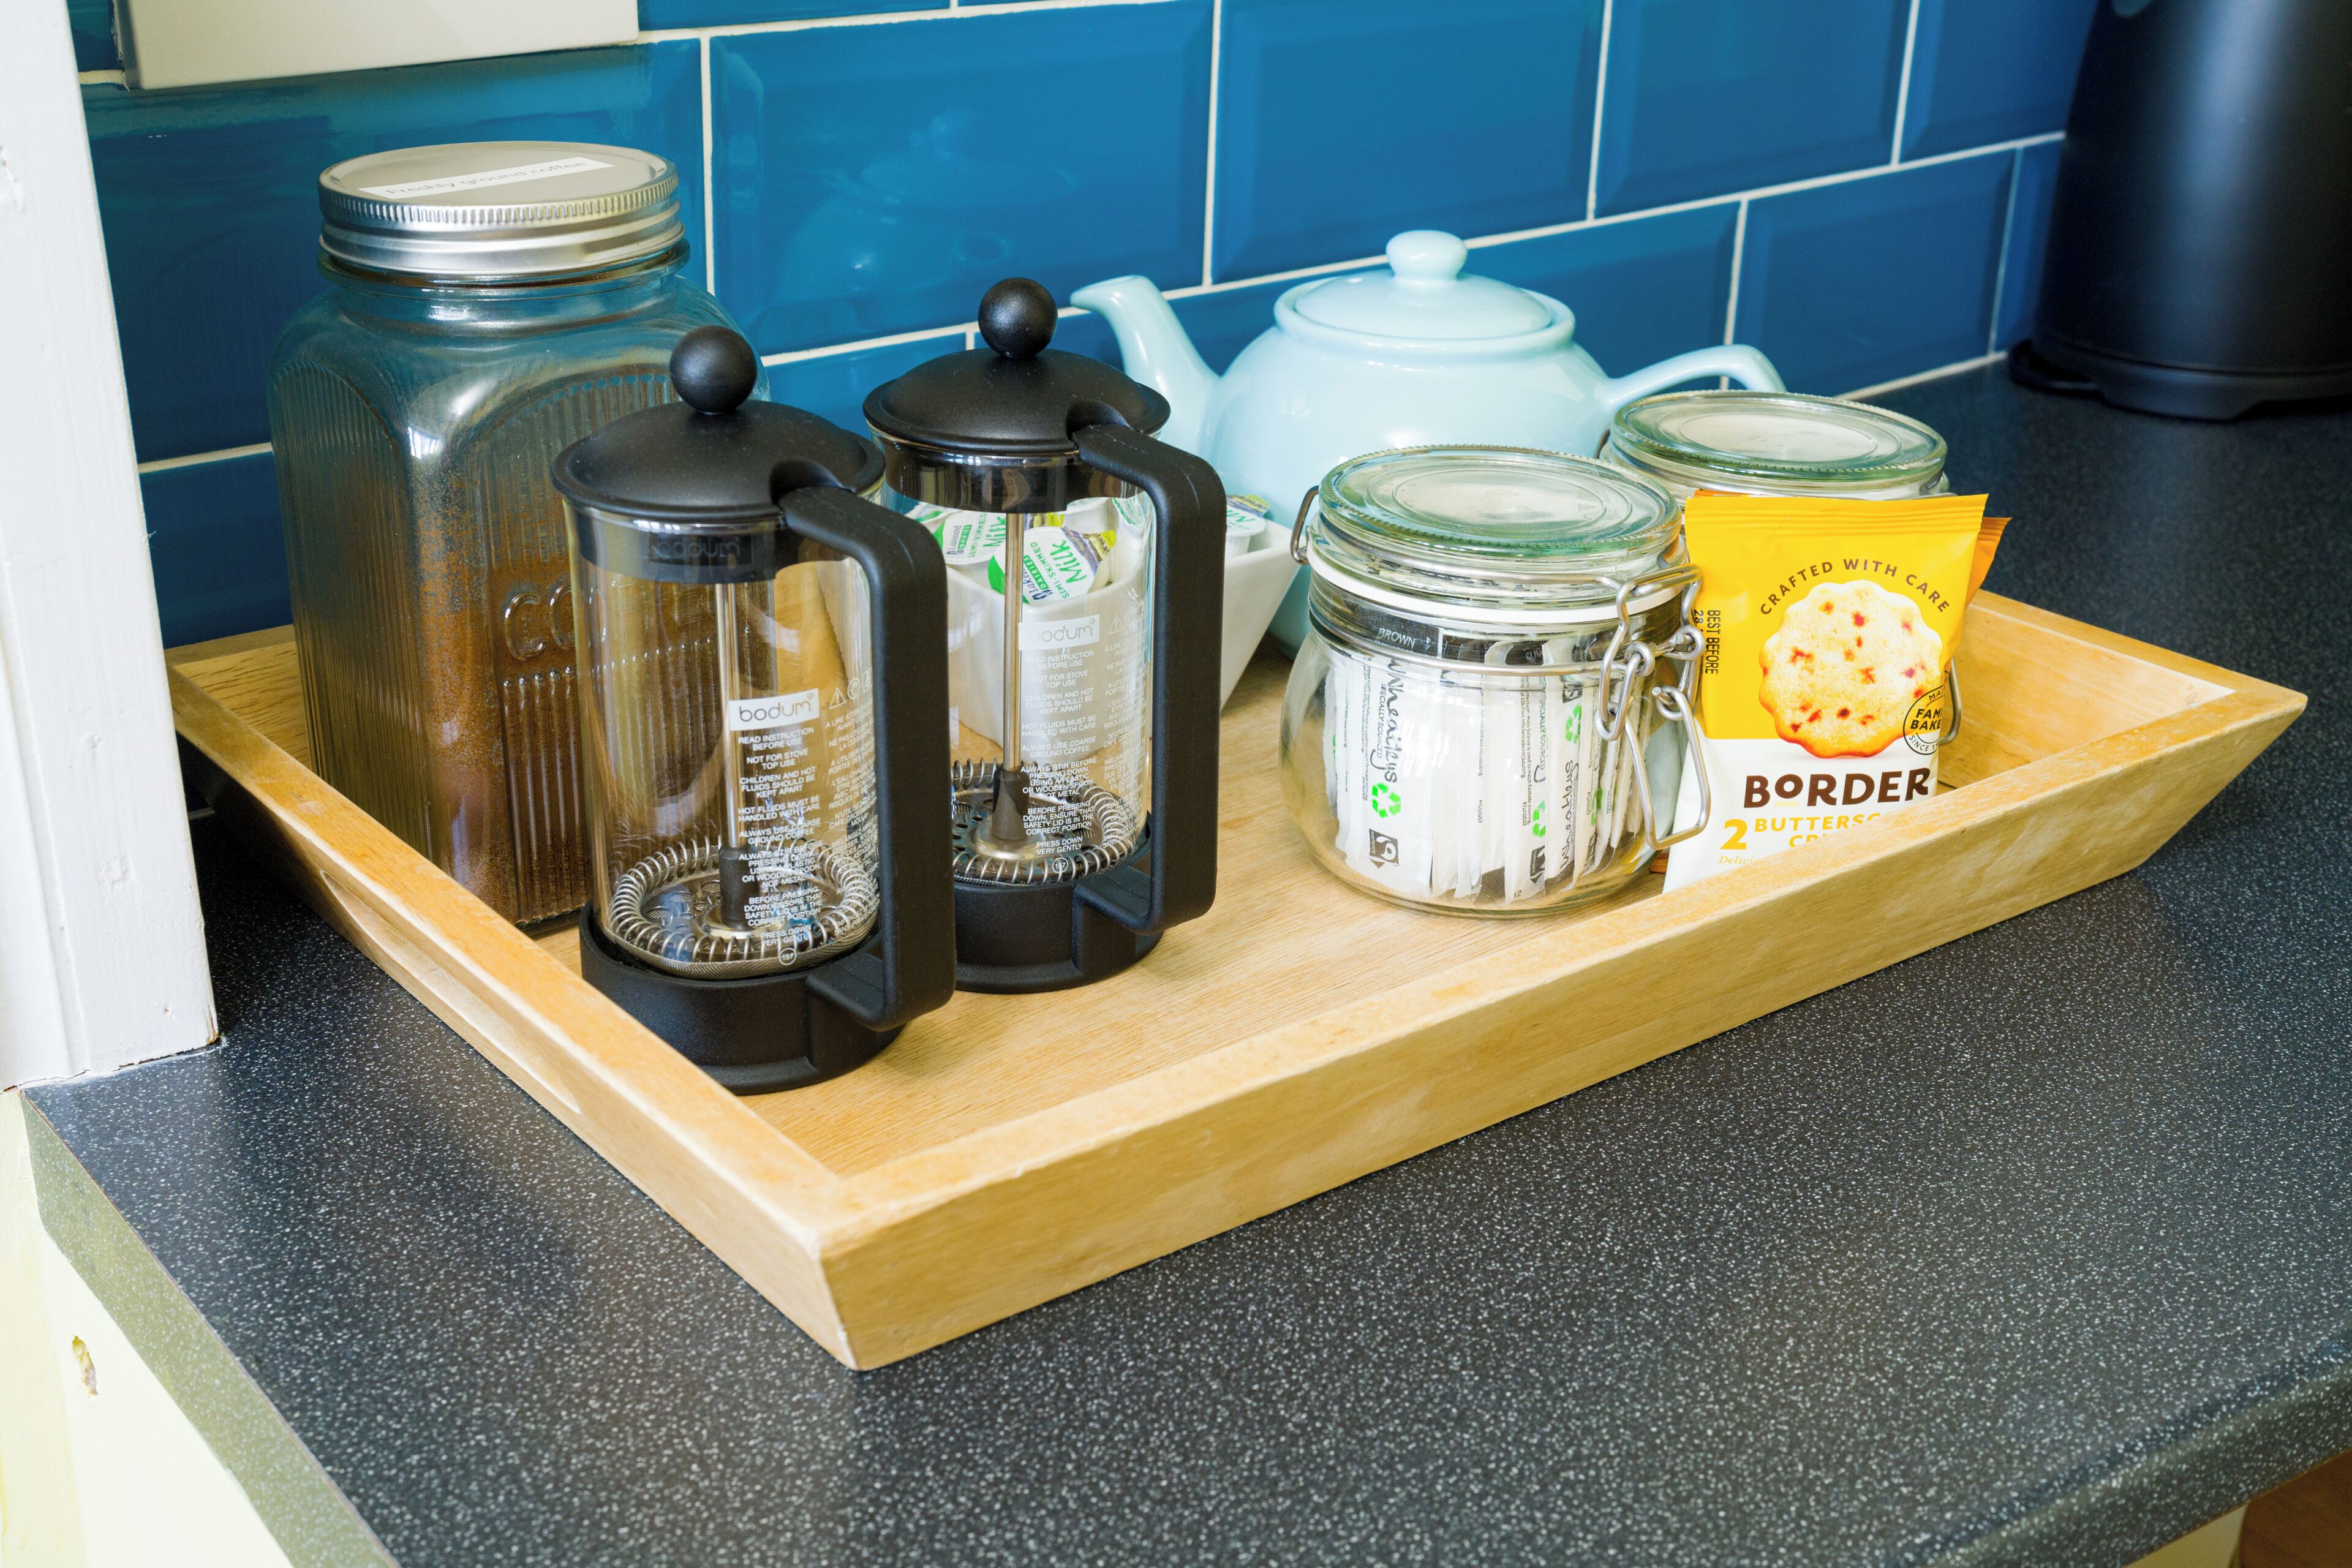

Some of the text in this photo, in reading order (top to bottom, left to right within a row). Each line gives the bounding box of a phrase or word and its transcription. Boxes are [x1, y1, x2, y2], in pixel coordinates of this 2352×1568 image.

[386, 162, 587, 195] Freshly ground coffee
[983, 516, 1006, 547] Milk
[1050, 540, 1087, 583] Milk
[1024, 556, 1048, 589] DAIRIES
[1030, 542, 1069, 598] SEMI-SKIMMED
[1760, 559, 1950, 614] CRAFTED WITH CARE
[1694, 609, 1703, 624] 28
[1376, 628, 1415, 649] BROWN
[1705, 610, 1721, 674] BEST BEFORE
[1049, 650, 1094, 662] INSTRUCTION
[1066, 670, 1088, 679] STOVE
[1055, 697, 1083, 706] SHOULD
[1378, 683, 1387, 722] SPECIALLY
[739, 701, 811, 722] bodum
[1060, 704, 1082, 714] APART
[1068, 717, 1086, 726] MUST
[1079, 722, 1096, 731] CARE
[763, 727, 813, 742] INSTRUCTION
[753, 741, 785, 751] BEFORE
[1069, 736, 1096, 747] COARSE
[1909, 735, 1929, 752] SINCE
[766, 753, 782, 762] FOR
[784, 748, 809, 758] STOVE
[1064, 745, 1090, 754] COFFEE
[1071, 757, 1097, 768] BEFORE
[741, 766, 816, 785] CHILDREN AND HOT
[1030, 771, 1065, 779] PRESSING
[1062, 774, 1088, 783] PLASTIC
[742, 782, 770, 792] FLUIDS
[772, 777, 804, 788] SHOULD
[1744, 767, 1931, 809] BORDER
[756, 785, 803, 798] KEPT APART
[788, 798, 809, 807] MUST
[1058, 801, 1090, 812] PRESSING
[739, 802, 820, 822] HANDLED CARE
[1050, 811, 1077, 820] ENSURE
[1080, 806, 1094, 815] THAT
[1560, 760, 1578, 869] Wheatleys
[739, 828, 771, 837] ALWAYS
[1026, 821, 1091, 835] CORRECT POSITION
[1720, 818, 1747, 850] 2
[748, 835, 783, 845] GROUND
[1062, 836, 1083, 845] DOWN
[1057, 843, 1082, 853] GENTLY
[739, 851, 772, 860] ALWAYS
[749, 895, 780, 904] BEFORE
[807, 892, 823, 901] THAT
[745, 910, 775, 919] SAFETY
[748, 909, 820, 926] CORRECT POSITION
[761, 930, 786, 938] PRESS
